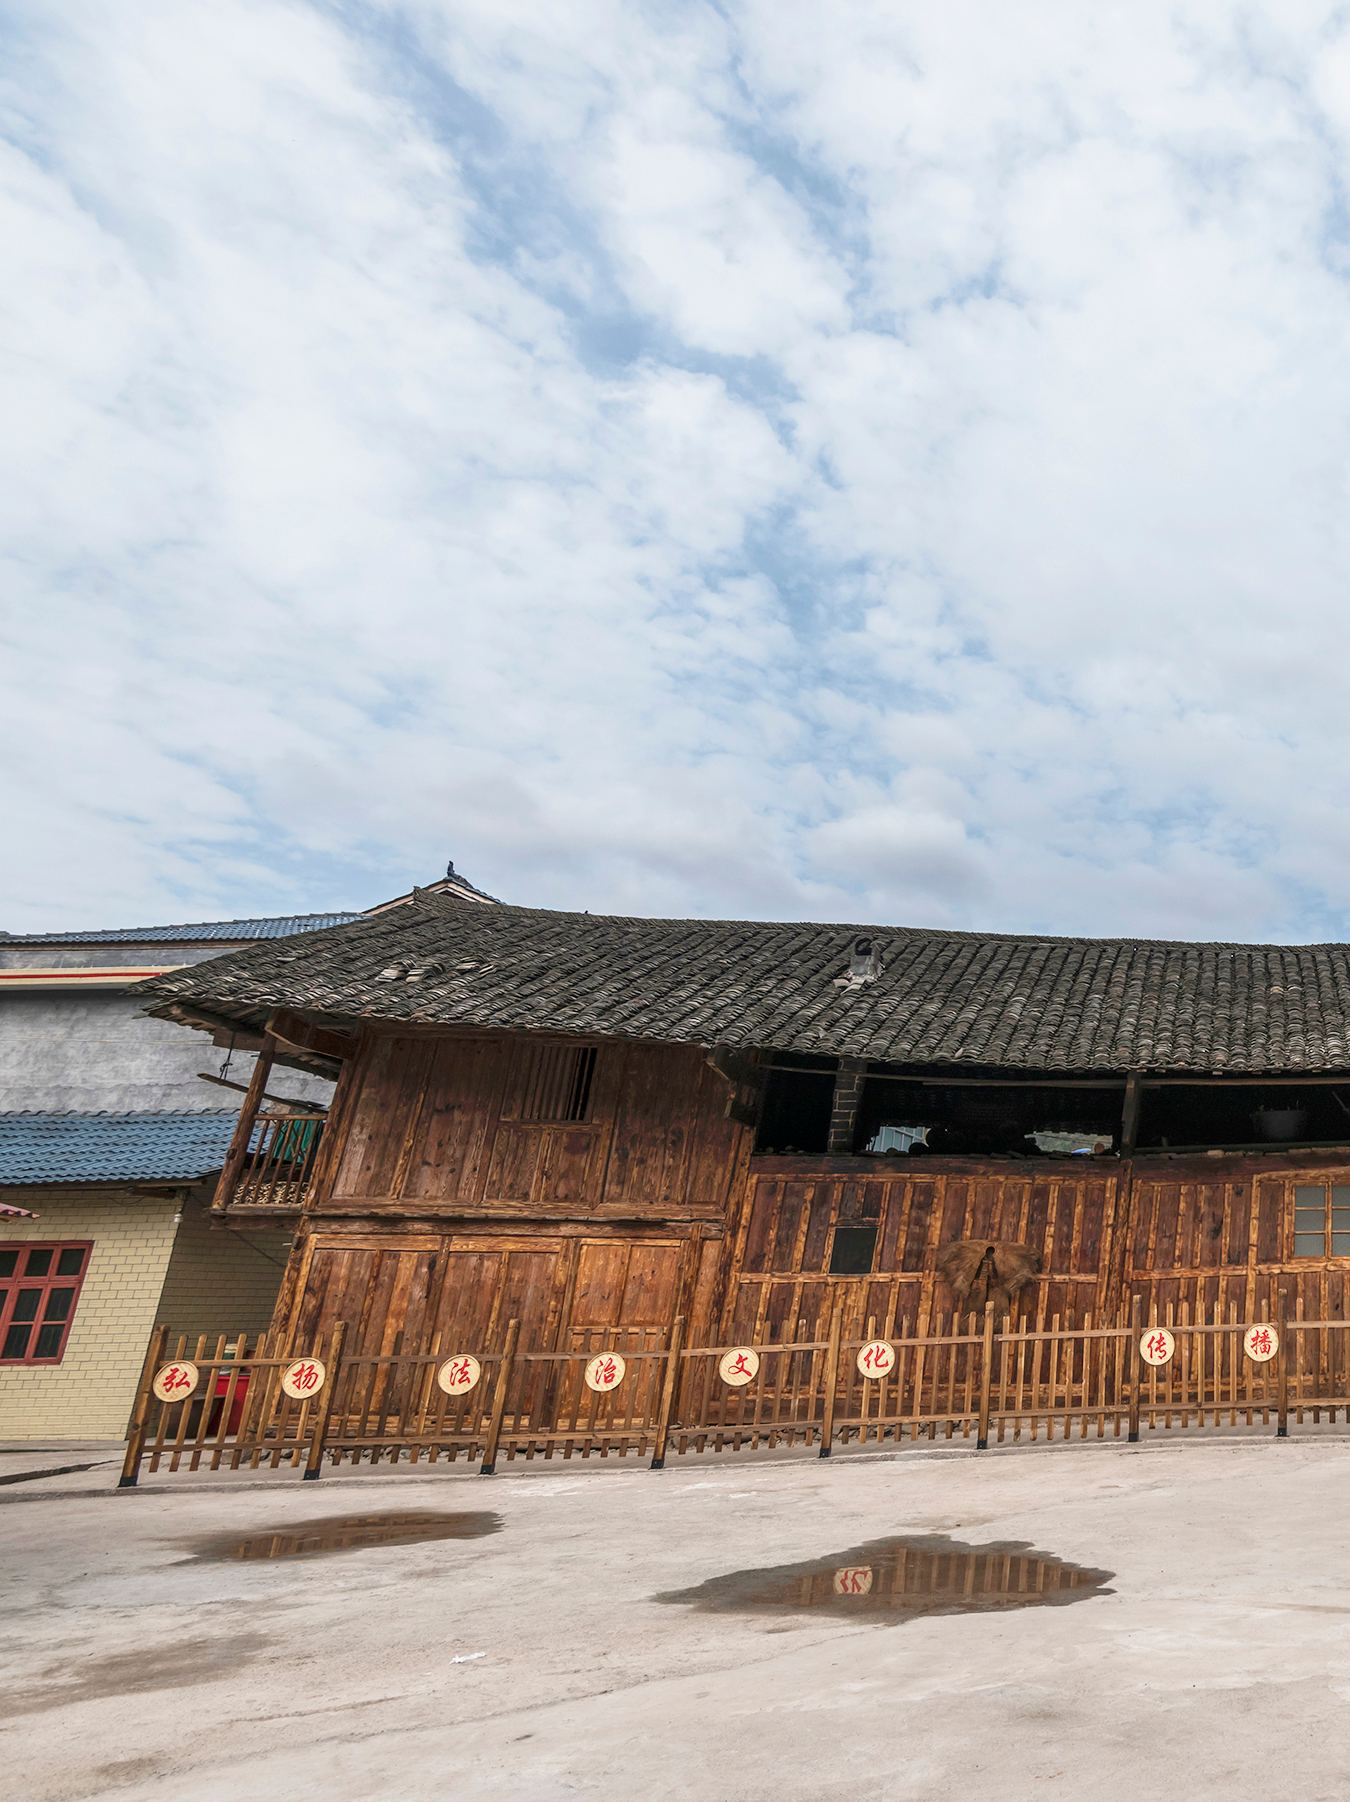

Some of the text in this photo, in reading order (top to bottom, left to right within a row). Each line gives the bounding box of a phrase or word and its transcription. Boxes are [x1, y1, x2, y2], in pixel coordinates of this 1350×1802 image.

[1146, 1332, 1168, 1360] 传
[1250, 1329, 1273, 1355] 播
[162, 1345, 890, 1394] 弘 扬 法 治 文 化
